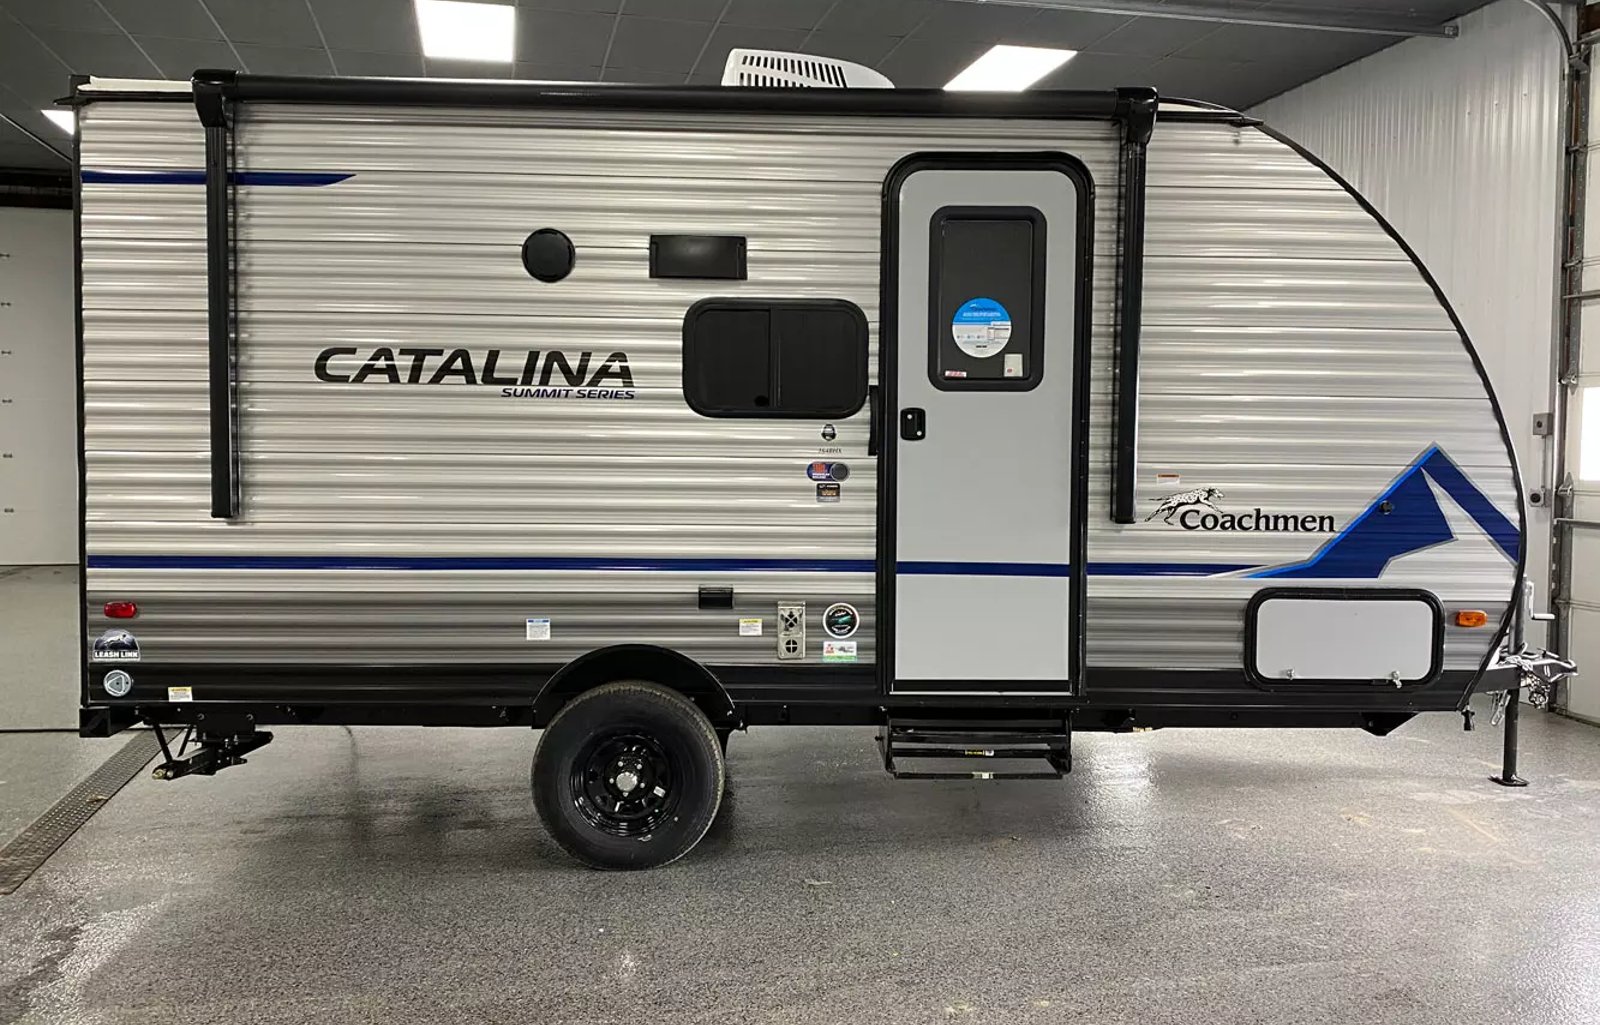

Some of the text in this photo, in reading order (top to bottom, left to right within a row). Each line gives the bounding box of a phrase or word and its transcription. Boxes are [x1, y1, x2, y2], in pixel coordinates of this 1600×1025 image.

[314, 347, 635, 388] CATALINA
[501, 387, 636, 400] SUMMIT SERIES
[1179, 508, 1336, 532] Coachmen
[94, 650, 139, 658] LEASH LINK
